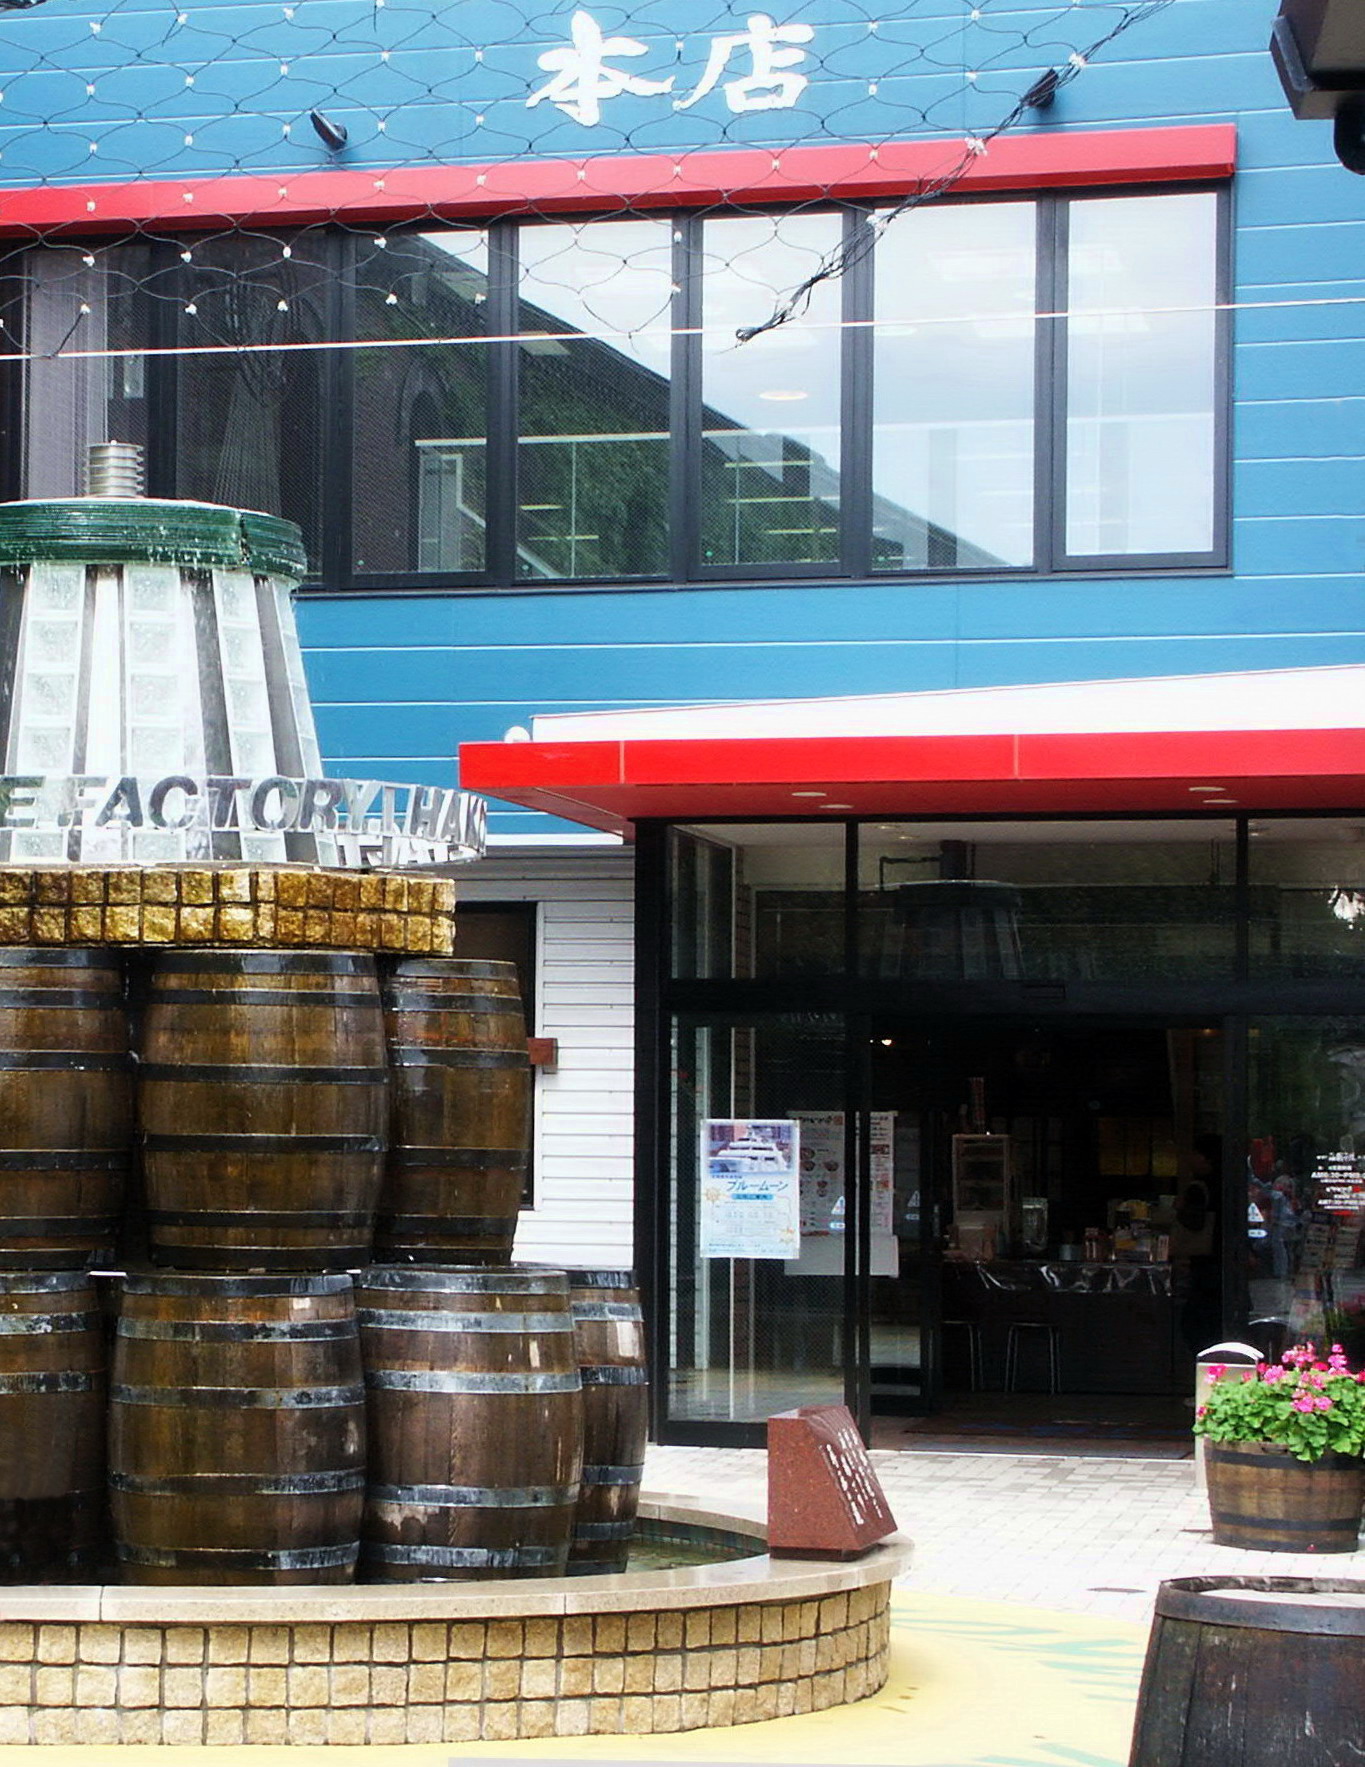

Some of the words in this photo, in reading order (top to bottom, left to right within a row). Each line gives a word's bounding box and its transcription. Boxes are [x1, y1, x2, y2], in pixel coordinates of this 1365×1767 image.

[526, 11, 815, 126] 本店
[726, 1179, 789, 1192] ブルームーン
